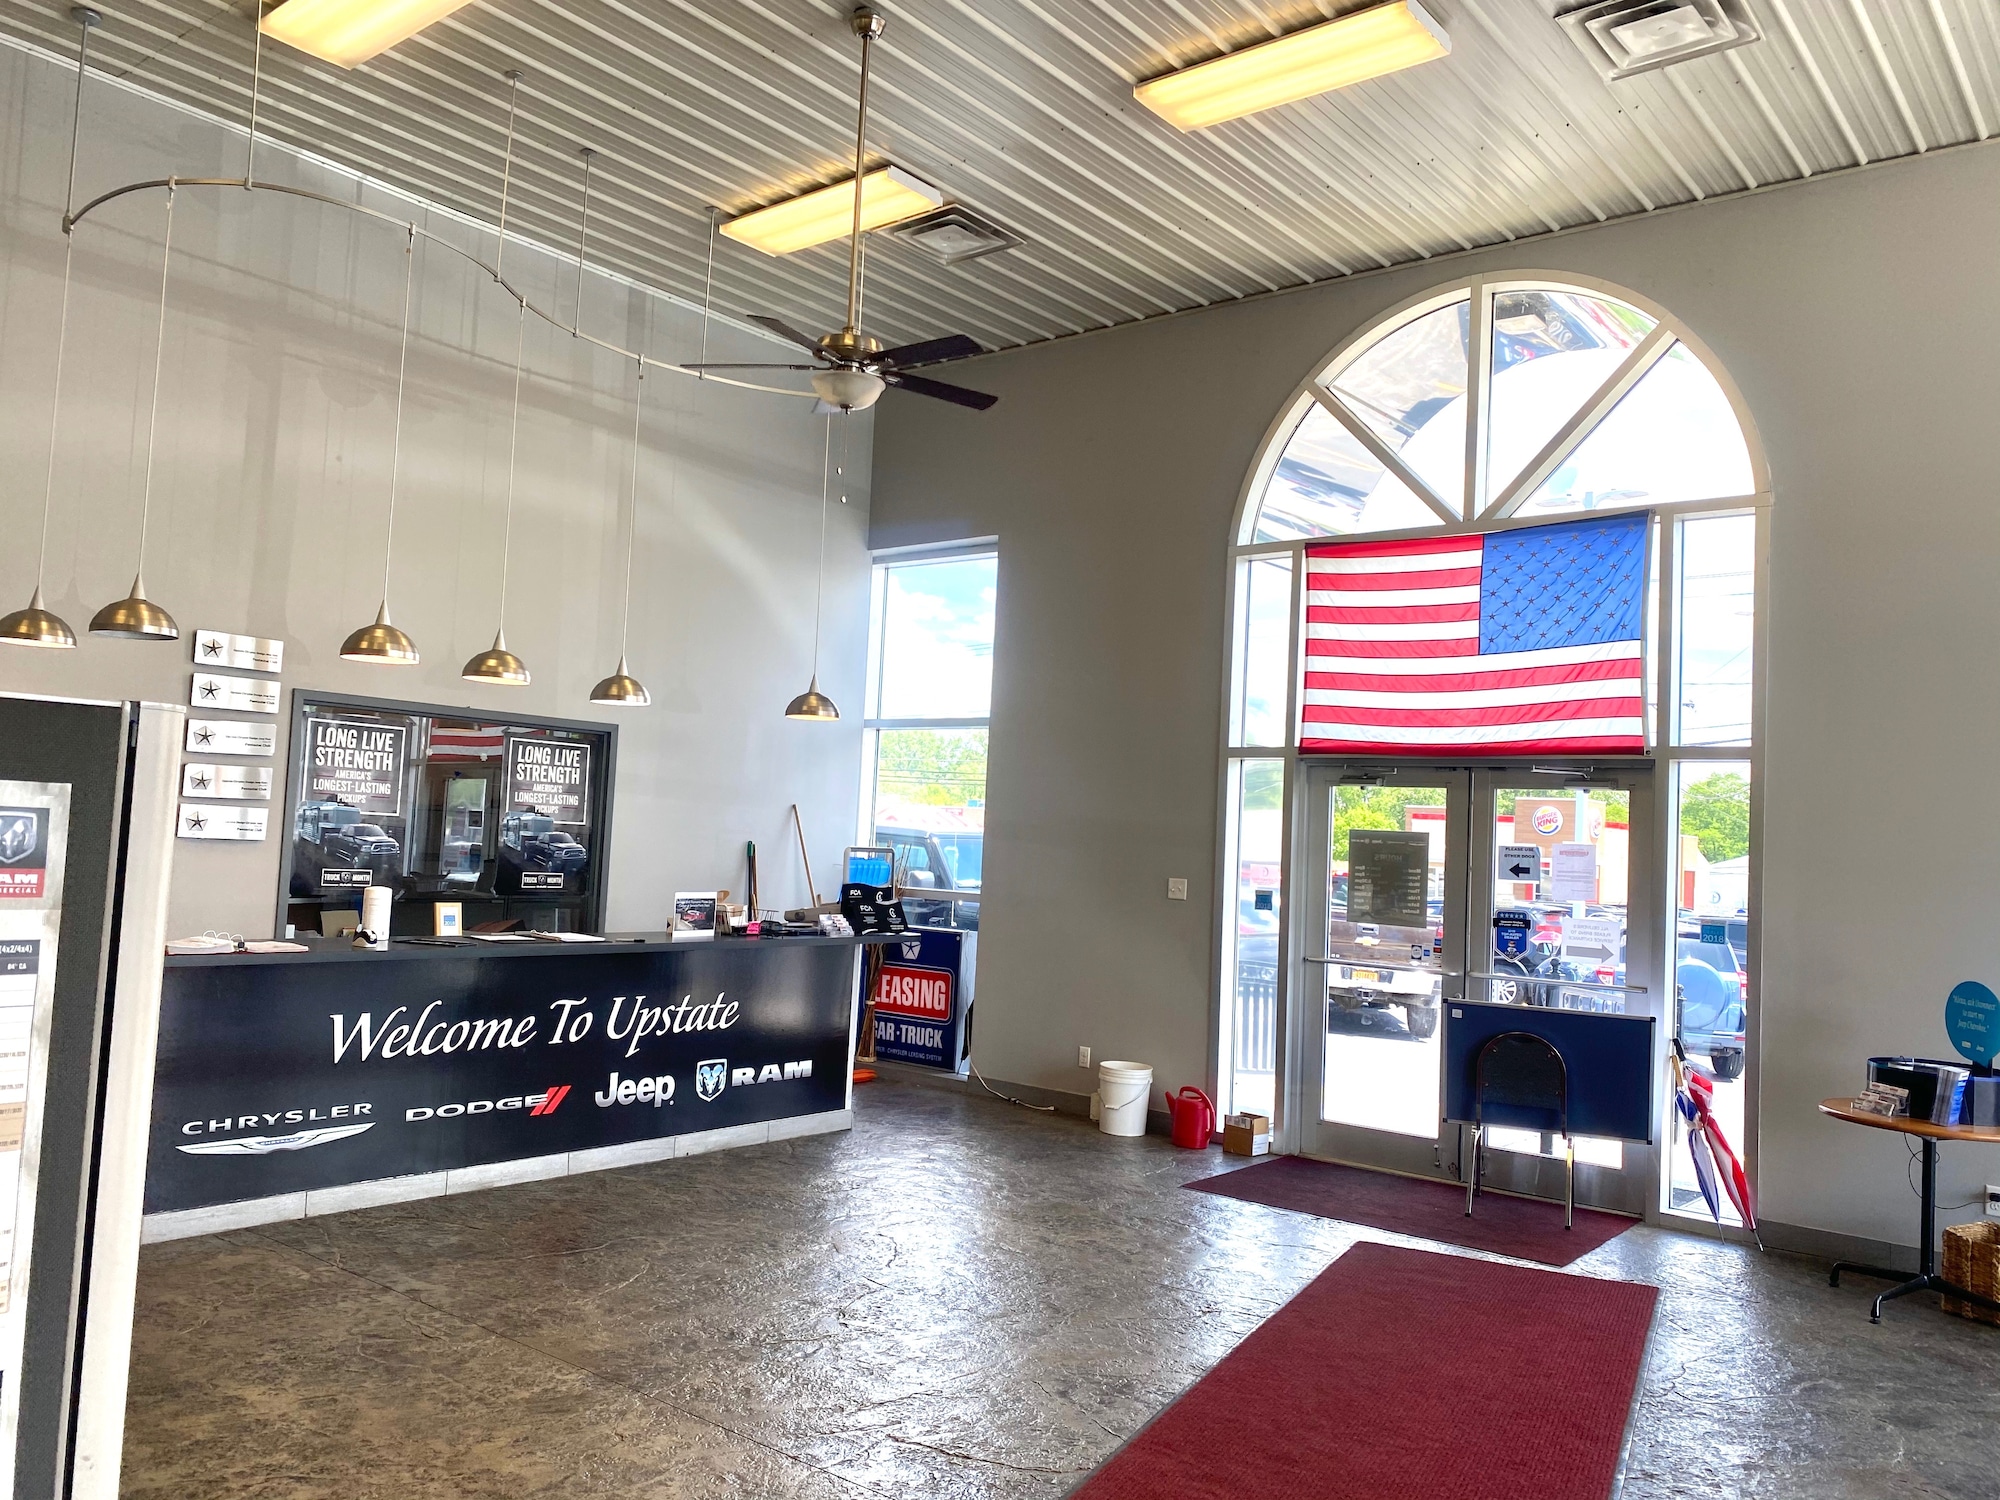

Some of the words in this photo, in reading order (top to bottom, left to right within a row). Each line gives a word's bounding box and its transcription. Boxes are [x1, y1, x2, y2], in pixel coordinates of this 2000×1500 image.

[317, 726, 357, 748] LONG
[362, 731, 394, 752] LIVE
[316, 747, 393, 771] STRENGTH
[518, 745, 551, 765] LONG
[555, 749, 581, 767] LIVE
[335, 770, 372, 780] AMERICA'S
[516, 763, 580, 784] STRENGTH
[313, 779, 391, 794] LONGEST-LASTING
[533, 784, 562, 793] AMERICA'S
[337, 793, 366, 803] PICKUPS
[515, 792, 578, 806] LONGEST-LASTING
[535, 805, 559, 813] PICKUPS
[1537, 817, 1558, 828] KING
[0, 874, 38, 884] AM
[1702, 934, 1724, 942] 2018
[330, 1000, 537, 1064] Welcome
[549, 997, 593, 1046] To
[607, 992, 740, 1058] Upstate
[732, 1059, 813, 1087] RAM
[595, 1072, 676, 1108] Jeep
[405, 1093, 549, 1122] DODGE
[181, 1102, 373, 1136] CHRYSLER
